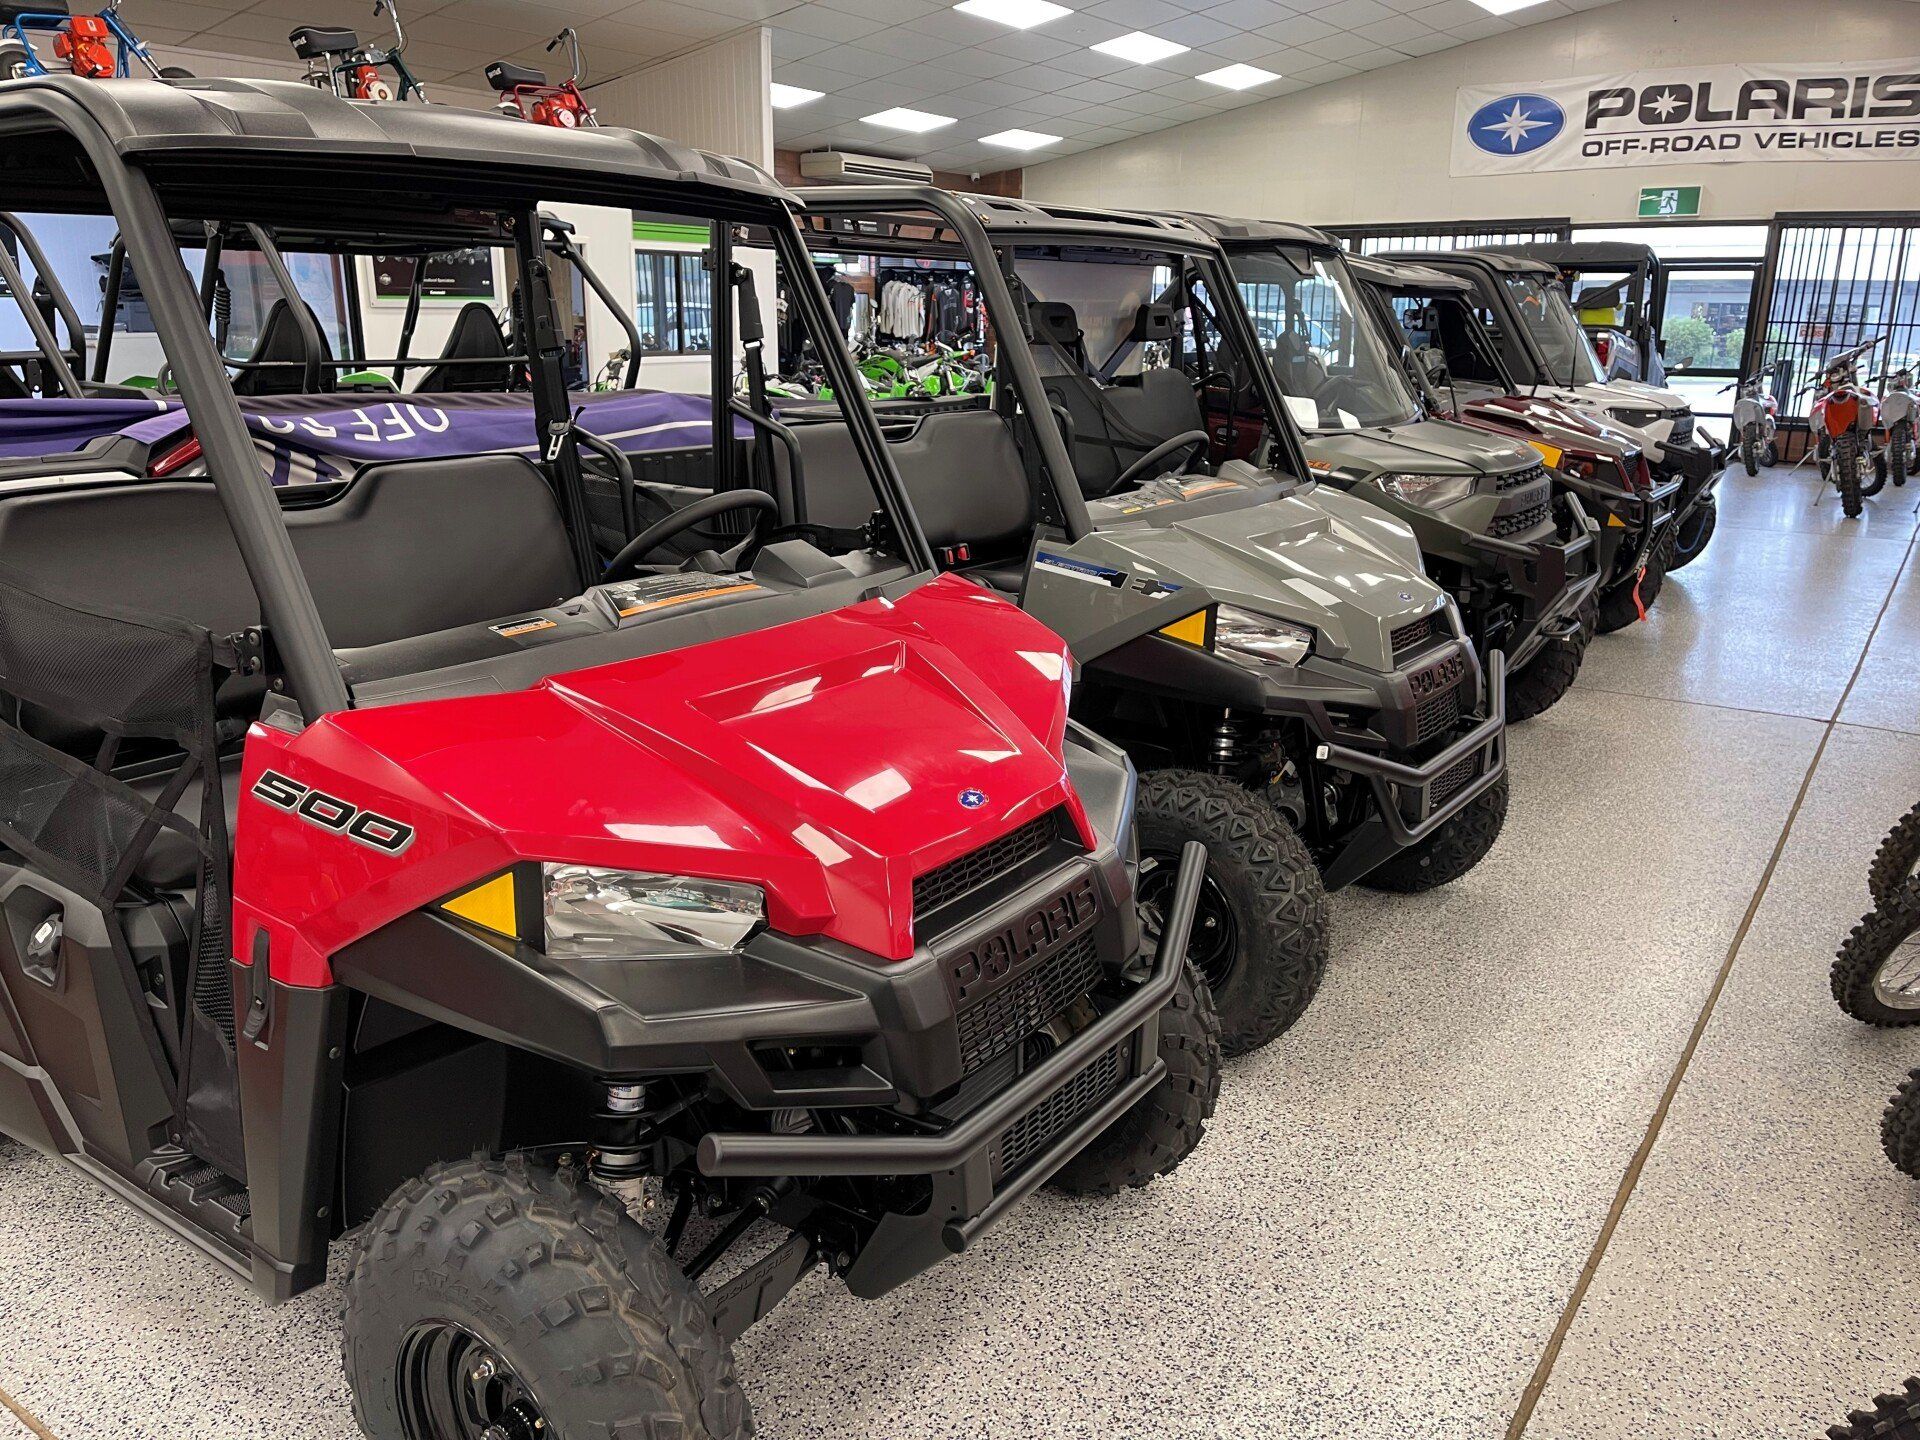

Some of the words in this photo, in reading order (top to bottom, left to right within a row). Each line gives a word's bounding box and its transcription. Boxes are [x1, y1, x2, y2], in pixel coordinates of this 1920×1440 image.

[1584, 74, 1920, 129] POLARIS
[1581, 133, 1742, 157] OFF-ROAD
[1754, 129, 1920, 150] VEHICLES
[1408, 651, 1465, 700] POLARIS
[251, 768, 417, 857] 500
[951, 877, 1098, 1002] POLARIS
